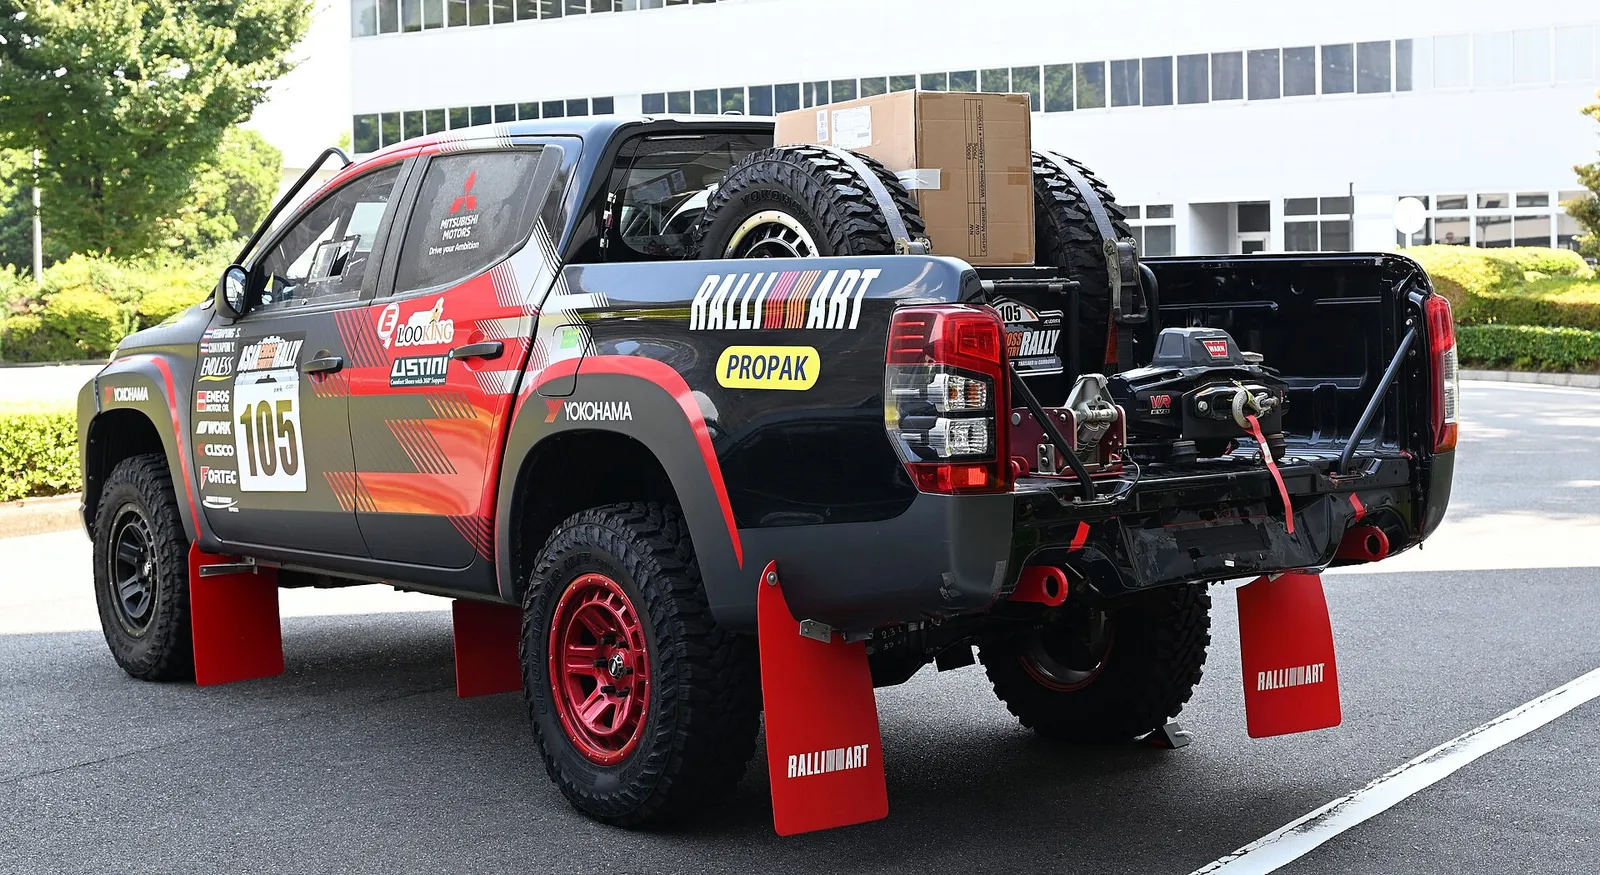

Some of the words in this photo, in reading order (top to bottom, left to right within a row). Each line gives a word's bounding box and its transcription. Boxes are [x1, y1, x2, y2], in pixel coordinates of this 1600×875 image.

[440, 214, 479, 229] MITSUBISHI
[740, 188, 820, 239] YOKOHAMA
[442, 227, 471, 240] MOTORS
[969, 224, 974, 235] NW
[975, 224, 980, 235] GW
[429, 246, 442, 255] Drive
[443, 245, 454, 255] your
[455, 241, 479, 251] Ambition
[689, 268, 883, 330] RALLIART
[999, 305, 1022, 322] 105
[397, 320, 453, 343] LOOKING
[1019, 329, 1060, 356] RALLY
[726, 355, 809, 381] PROPAK
[113, 387, 149, 401] YOKOHAMA
[206, 390, 230, 403] ENEOS
[1150, 395, 1171, 409] VR
[564, 401, 633, 421] YOKOHAMA
[206, 421, 232, 434] WORK
[240, 400, 299, 476] 105
[204, 444, 235, 457] CUSCO
[200, 466, 237, 489] FORTEC
[1257, 663, 1325, 691] RALLIART
[787, 744, 869, 778] RALLIART
